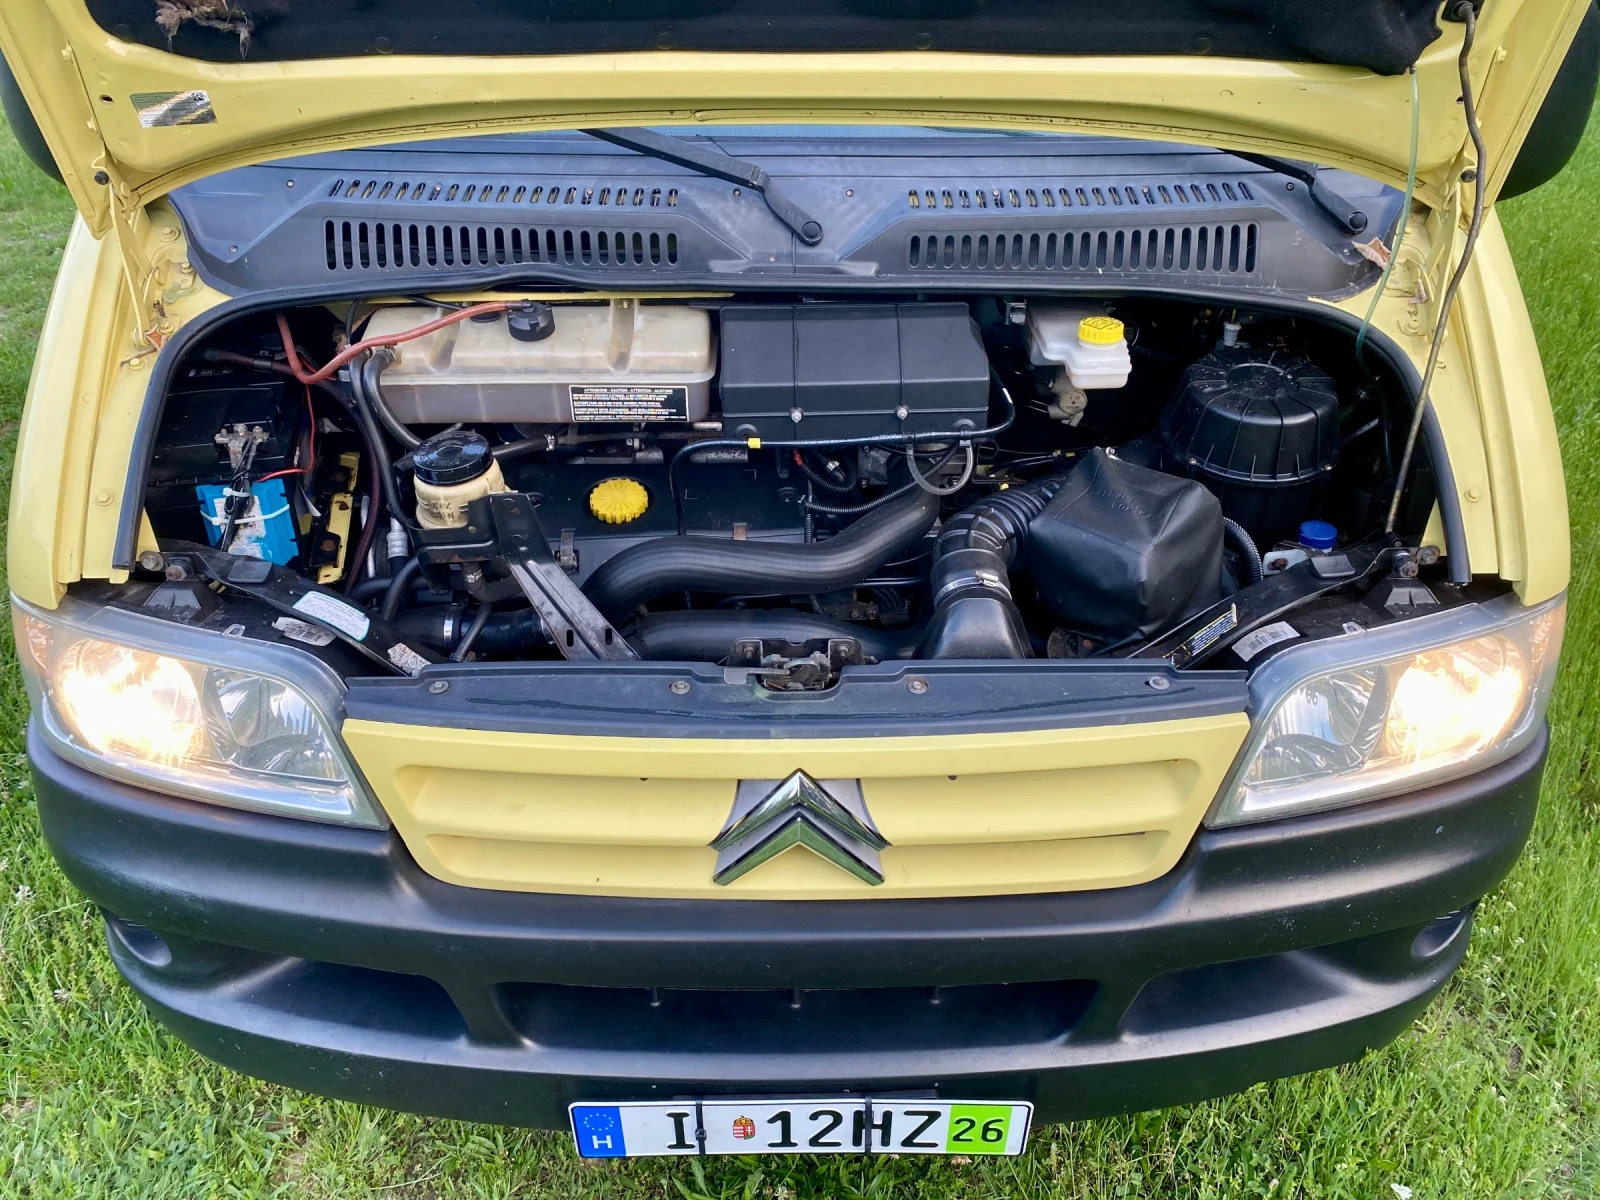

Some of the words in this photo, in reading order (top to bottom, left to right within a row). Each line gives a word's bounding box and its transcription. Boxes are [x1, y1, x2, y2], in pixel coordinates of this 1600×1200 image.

[592, 1135, 613, 1149] H
[666, 1111, 696, 1149] I
[952, 1117, 1004, 1143] 26
